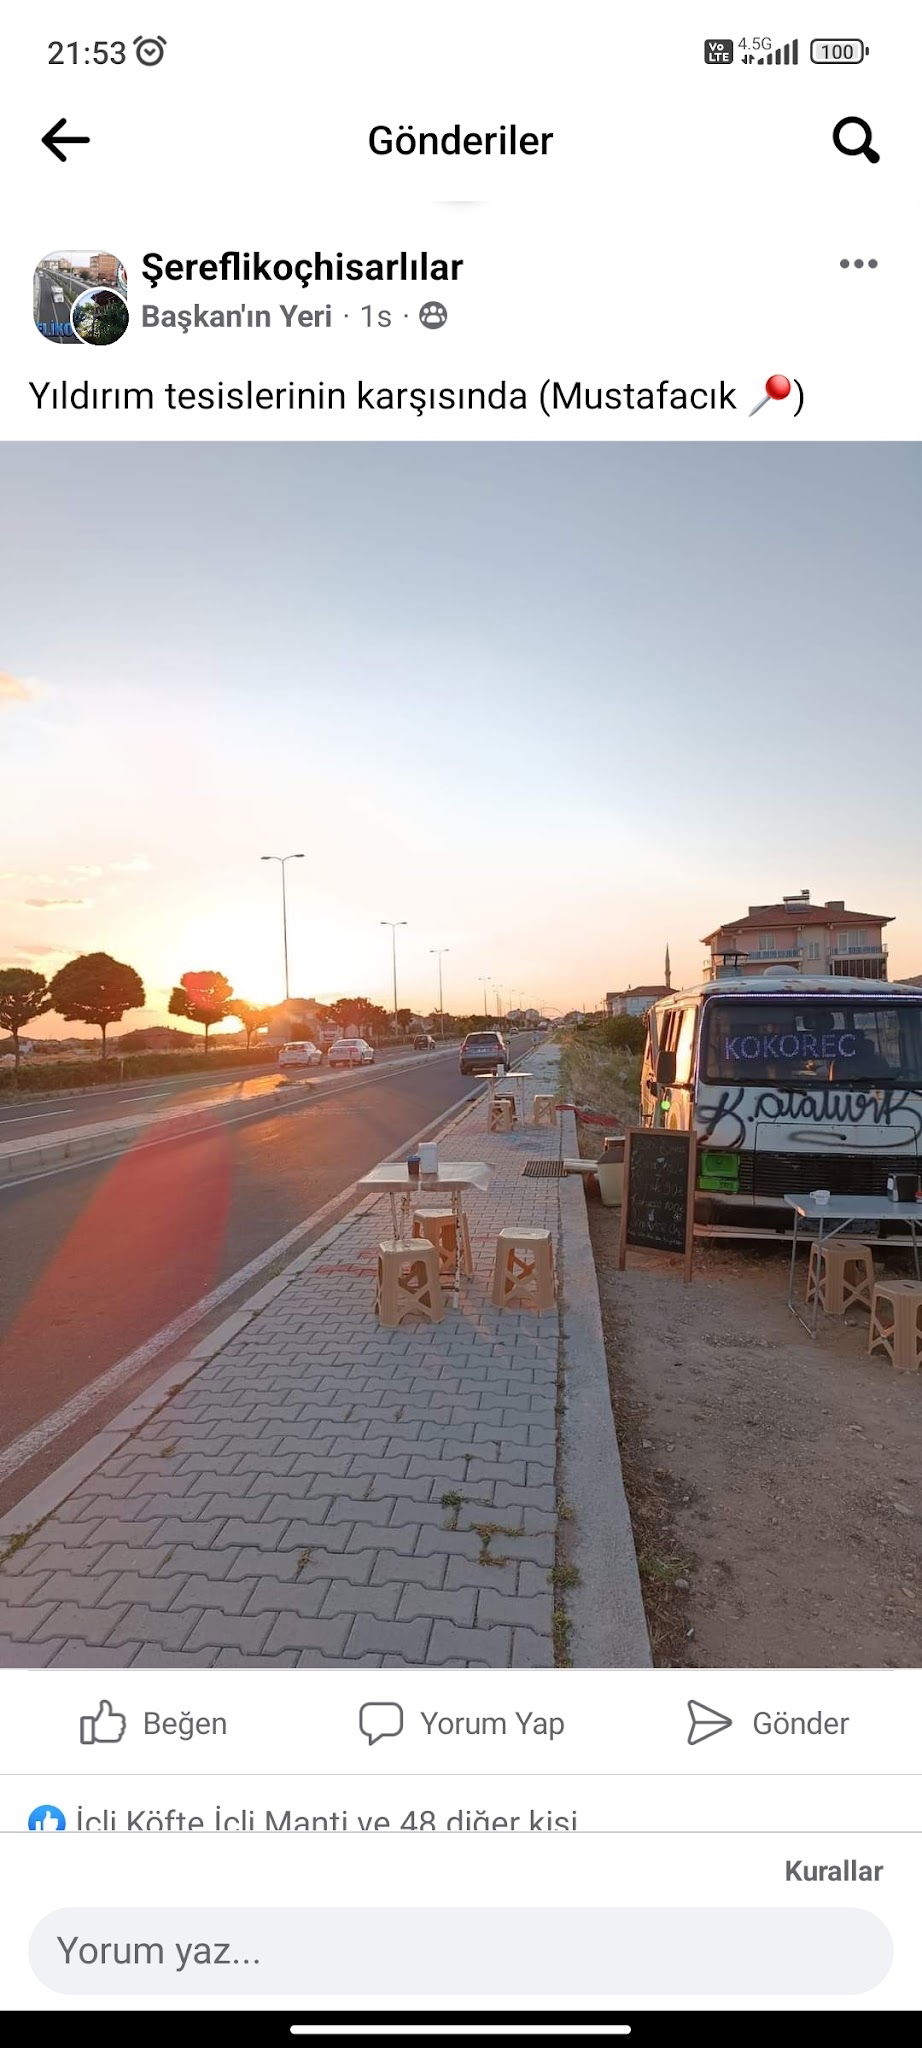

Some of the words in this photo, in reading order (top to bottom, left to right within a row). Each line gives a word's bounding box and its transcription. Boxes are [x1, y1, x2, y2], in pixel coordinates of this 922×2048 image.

[48, 41, 127, 64] 21:53
[709, 43, 724, 51] Vo
[738, 37, 772, 50] 4.5G
[822, 45, 854, 59] 100
[709, 53, 730, 62] LTE
[368, 124, 555, 156] Gönderiler
[142, 251, 464, 287] Şereflikoçhisarlılar
[142, 303, 271, 334] Başkan'ın
[280, 303, 332, 328] Yeri
[362, 304, 392, 328] 1s
[29, 380, 154, 410] Yıldırım
[165, 380, 346, 410] tesislerinin
[358, 379, 528, 417] karşısında
[540, 379, 738, 418] (Mustafacık
[144, 1711, 227, 1742] Beğen
[420, 1711, 507, 1735] Yorum
[515, 1711, 565, 1742] Yap
[754, 1711, 850, 1735] Gönder
[128, 1809, 204, 1831] Köfte
[358, 1816, 391, 1831] ve
[400, 1810, 436, 1831] 48
[447, 1809, 521, 1831] diğer
[785, 1858, 885, 1882] Kurallar
[57, 1936, 164, 1965] Yorum
[175, 1942, 260, 1973] yaz...
